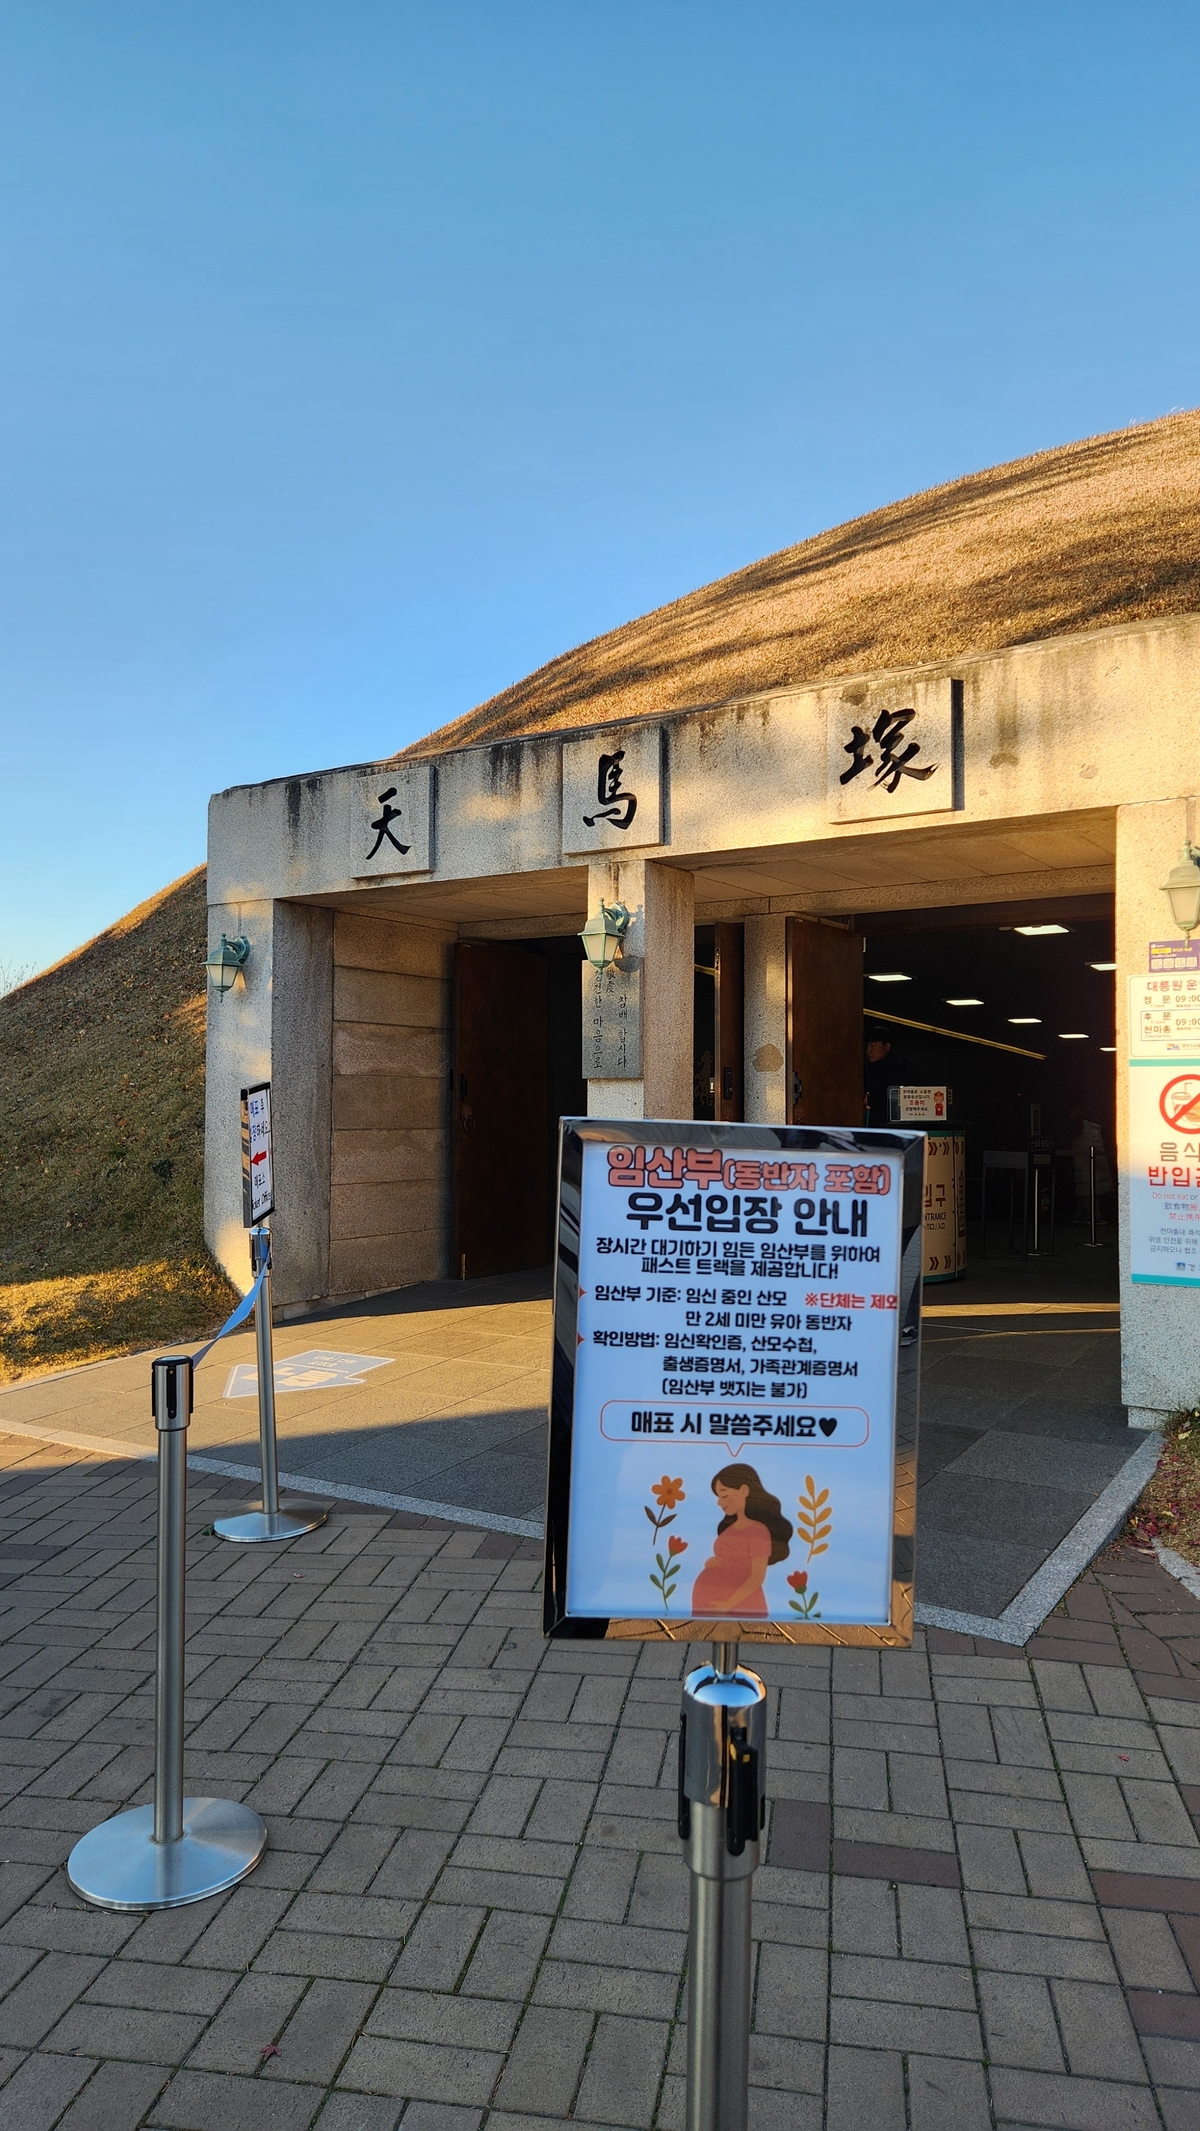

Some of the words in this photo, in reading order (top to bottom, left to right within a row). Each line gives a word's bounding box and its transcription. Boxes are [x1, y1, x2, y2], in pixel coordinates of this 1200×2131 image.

[1147, 980, 1182, 992] 대릉원
[618, 994, 628, 1020] 참배
[1144, 1025, 1171, 1034] 천마총
[593, 1016, 603, 1069] 마음으로
[617, 1028, 628, 1068] 합시다
[607, 1144, 820, 1192] 임산부(동반자
[823, 1163, 891, 1196] 포함)
[626, 1192, 783, 1234] 우선입장
[793, 1198, 868, 1237] 안내
[596, 1237, 647, 1254] 장시간
[651, 1239, 717, 1257] 대기하기
[722, 1241, 755, 1258] 힘든
[761, 1242, 826, 1260] 임산부를
[831, 1245, 880, 1262] 위하여
[641, 1257, 691, 1274] 패스트
[696, 1258, 746, 1276] 트랙을
[750, 1260, 838, 1279] 제공합니다!
[595, 1285, 641, 1301] 임산부
[646, 1286, 681, 1303] 기준:
[686, 1288, 717, 1304] 임신
[721, 1289, 752, 1305] 중인
[756, 1290, 787, 1306] 산모
[685, 1310, 701, 1327] 만
[705, 1311, 731, 1328] 2세
[735, 1312, 766, 1329] 미만
[770, 1313, 802, 1330] 유아
[805, 1314, 852, 1331] 동반자
[593, 1330, 660, 1348] 확인방법:
[664, 1332, 747, 1352] 임신확인증,
[751, 1335, 817, 1354] 산모수첩,
[662, 1355, 745, 1375] 출생증명서,
[750, 1358, 858, 1377] 가족관계증명서
[662, 1378, 715, 1396] (임산부
[770, 1381, 807, 1399] 불가)
[631, 1411, 675, 1434] 매표
[680, 1412, 702, 1435] 시
